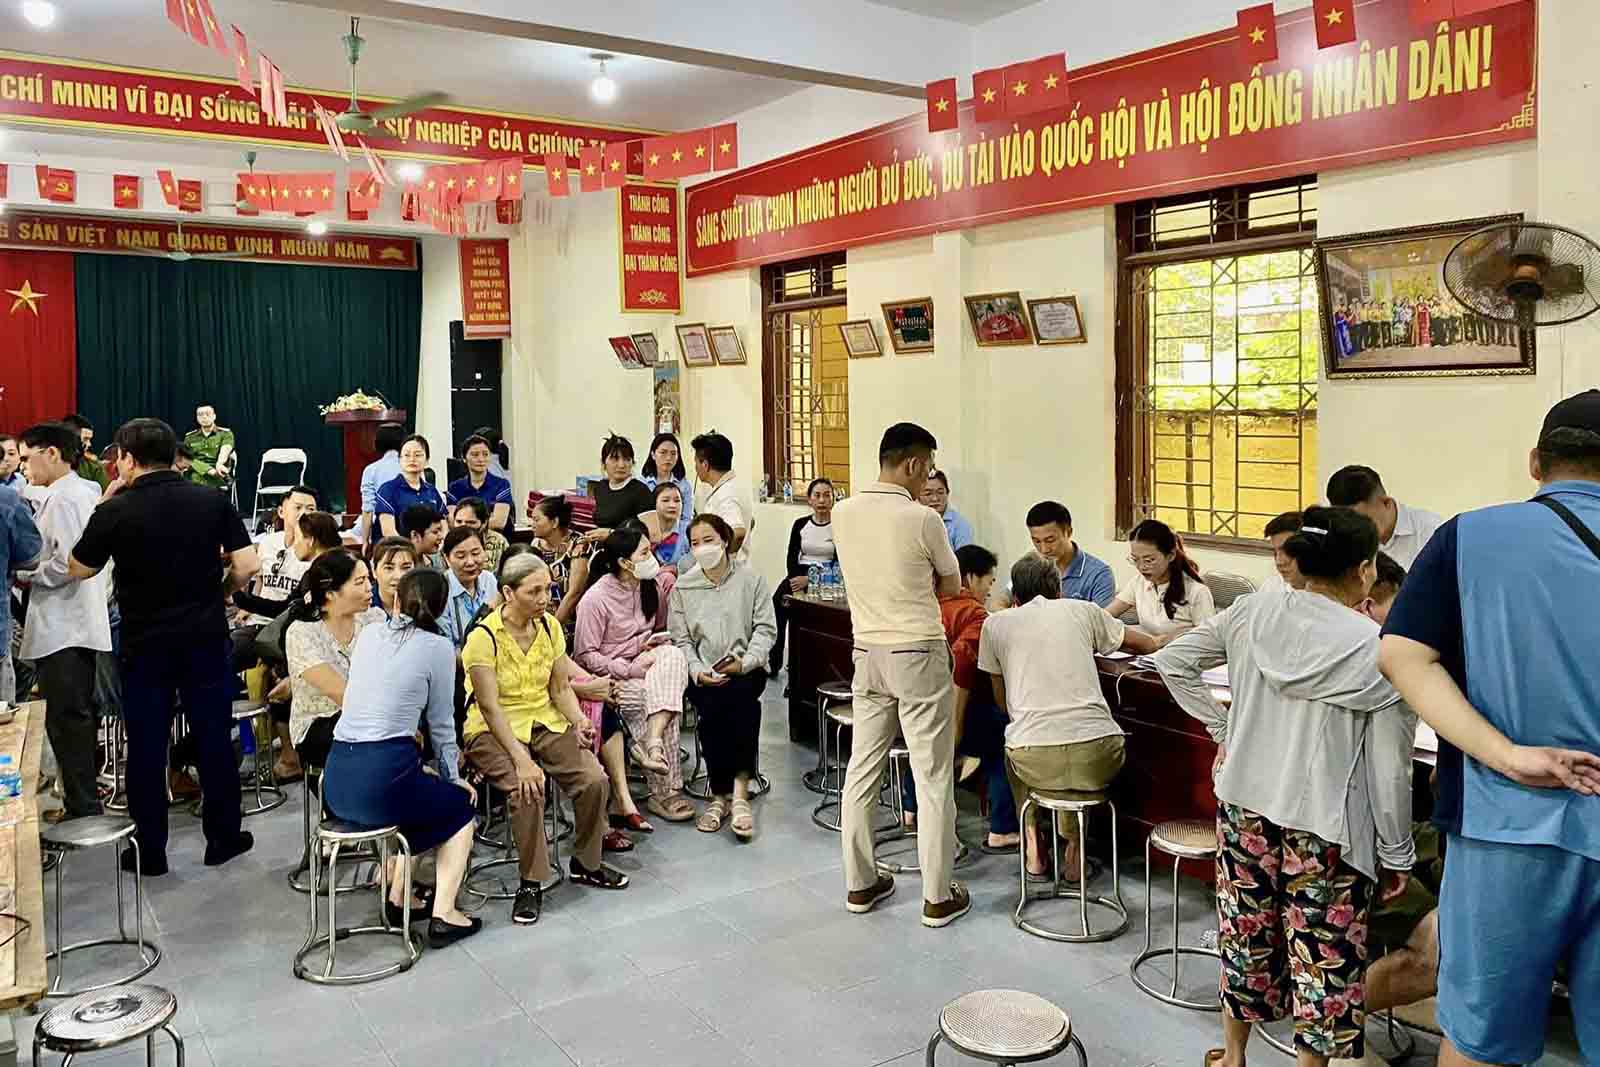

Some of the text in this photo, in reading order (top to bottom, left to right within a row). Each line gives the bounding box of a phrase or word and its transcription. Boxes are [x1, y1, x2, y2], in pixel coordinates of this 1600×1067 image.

[0, 73, 43, 104] CHÍ
[52, 79, 118, 112] MINH
[124, 84, 147, 113] VĨ
[154, 91, 193, 122] ĐẠI
[200, 90, 260, 125] SỐNG
[385, 116, 412, 145] SỰ
[415, 120, 483, 152] NGHIỆP
[488, 120, 523, 153] CỦA
[528, 131, 584, 160] CHÚNG
[695, 208, 719, 249] SÁNG
[721, 199, 743, 243] SUỐT
[745, 199, 764, 245] LỰA
[766, 192, 793, 240] CHỌN
[796, 177, 835, 225] NHỮNG
[839, 160, 878, 217] NGƯỜI
[881, 148, 900, 206] ĐỦ
[904, 147, 937, 201] ĐỨC,
[967, 131, 995, 188] TÀI
[999, 122, 1035, 181] VÀO
[1040, 101, 1094, 177] QUỐC
[1100, 97, 1137, 169] HỘI
[1143, 87, 1173, 152] VÀ
[1180, 77, 1222, 153] HỘI
[1311, 39, 1399, 121] NHÂN
[1407, 21, 1493, 101] DÂN!
[18, 217, 59, 241] SẢN
[66, 223, 107, 247] VIỆT
[116, 228, 160, 248] NAM
[167, 231, 227, 252] QUANG
[235, 235, 273, 255] VINH
